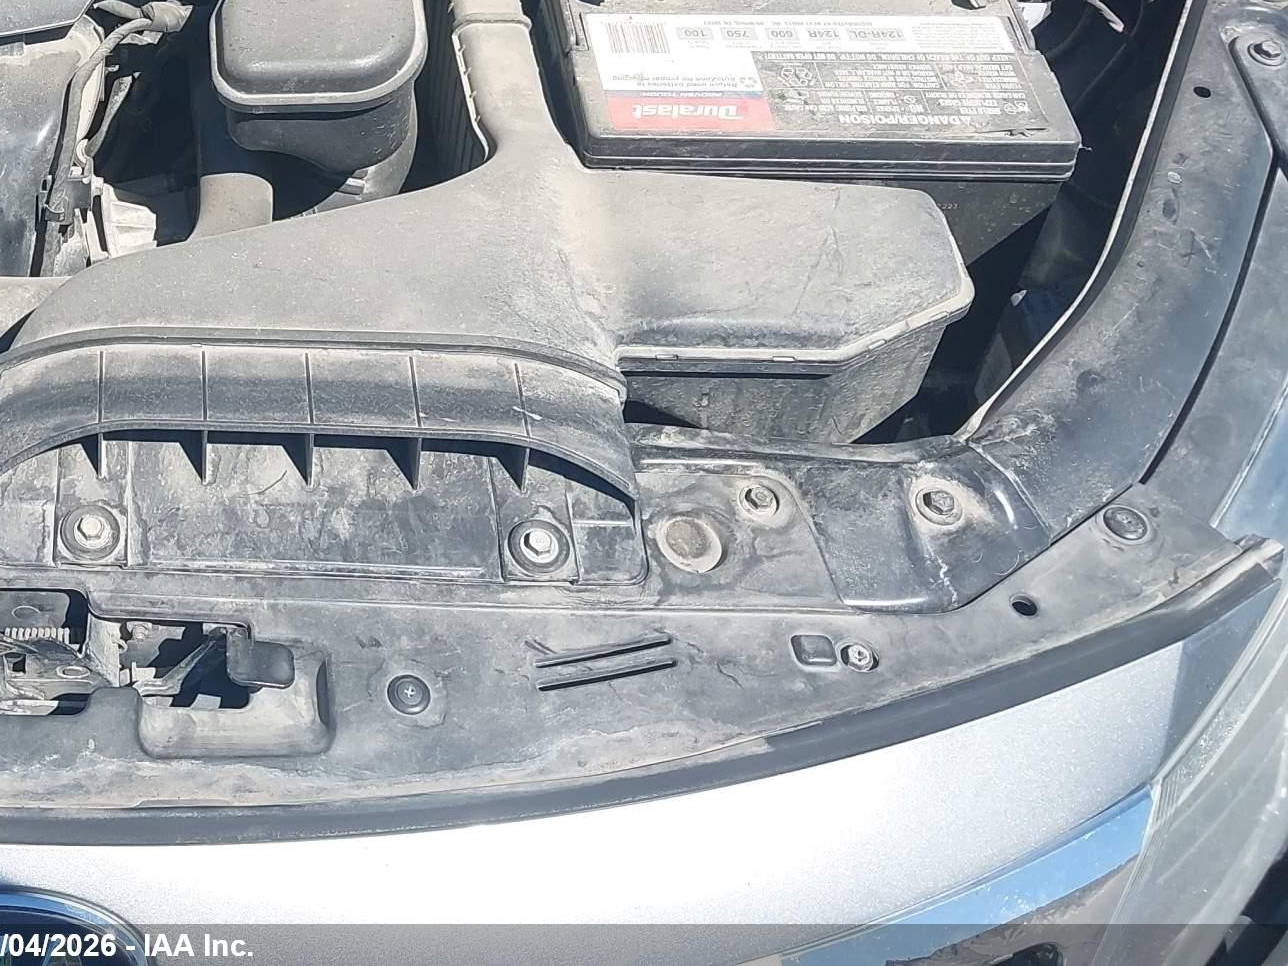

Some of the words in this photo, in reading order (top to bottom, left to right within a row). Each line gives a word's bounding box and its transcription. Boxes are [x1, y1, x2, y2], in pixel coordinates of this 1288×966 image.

[684, 30, 705, 38] 100
[726, 30, 750, 38] 750
[632, 104, 744, 120] Duralast
[838, 114, 960, 125] DANGER/POISON
